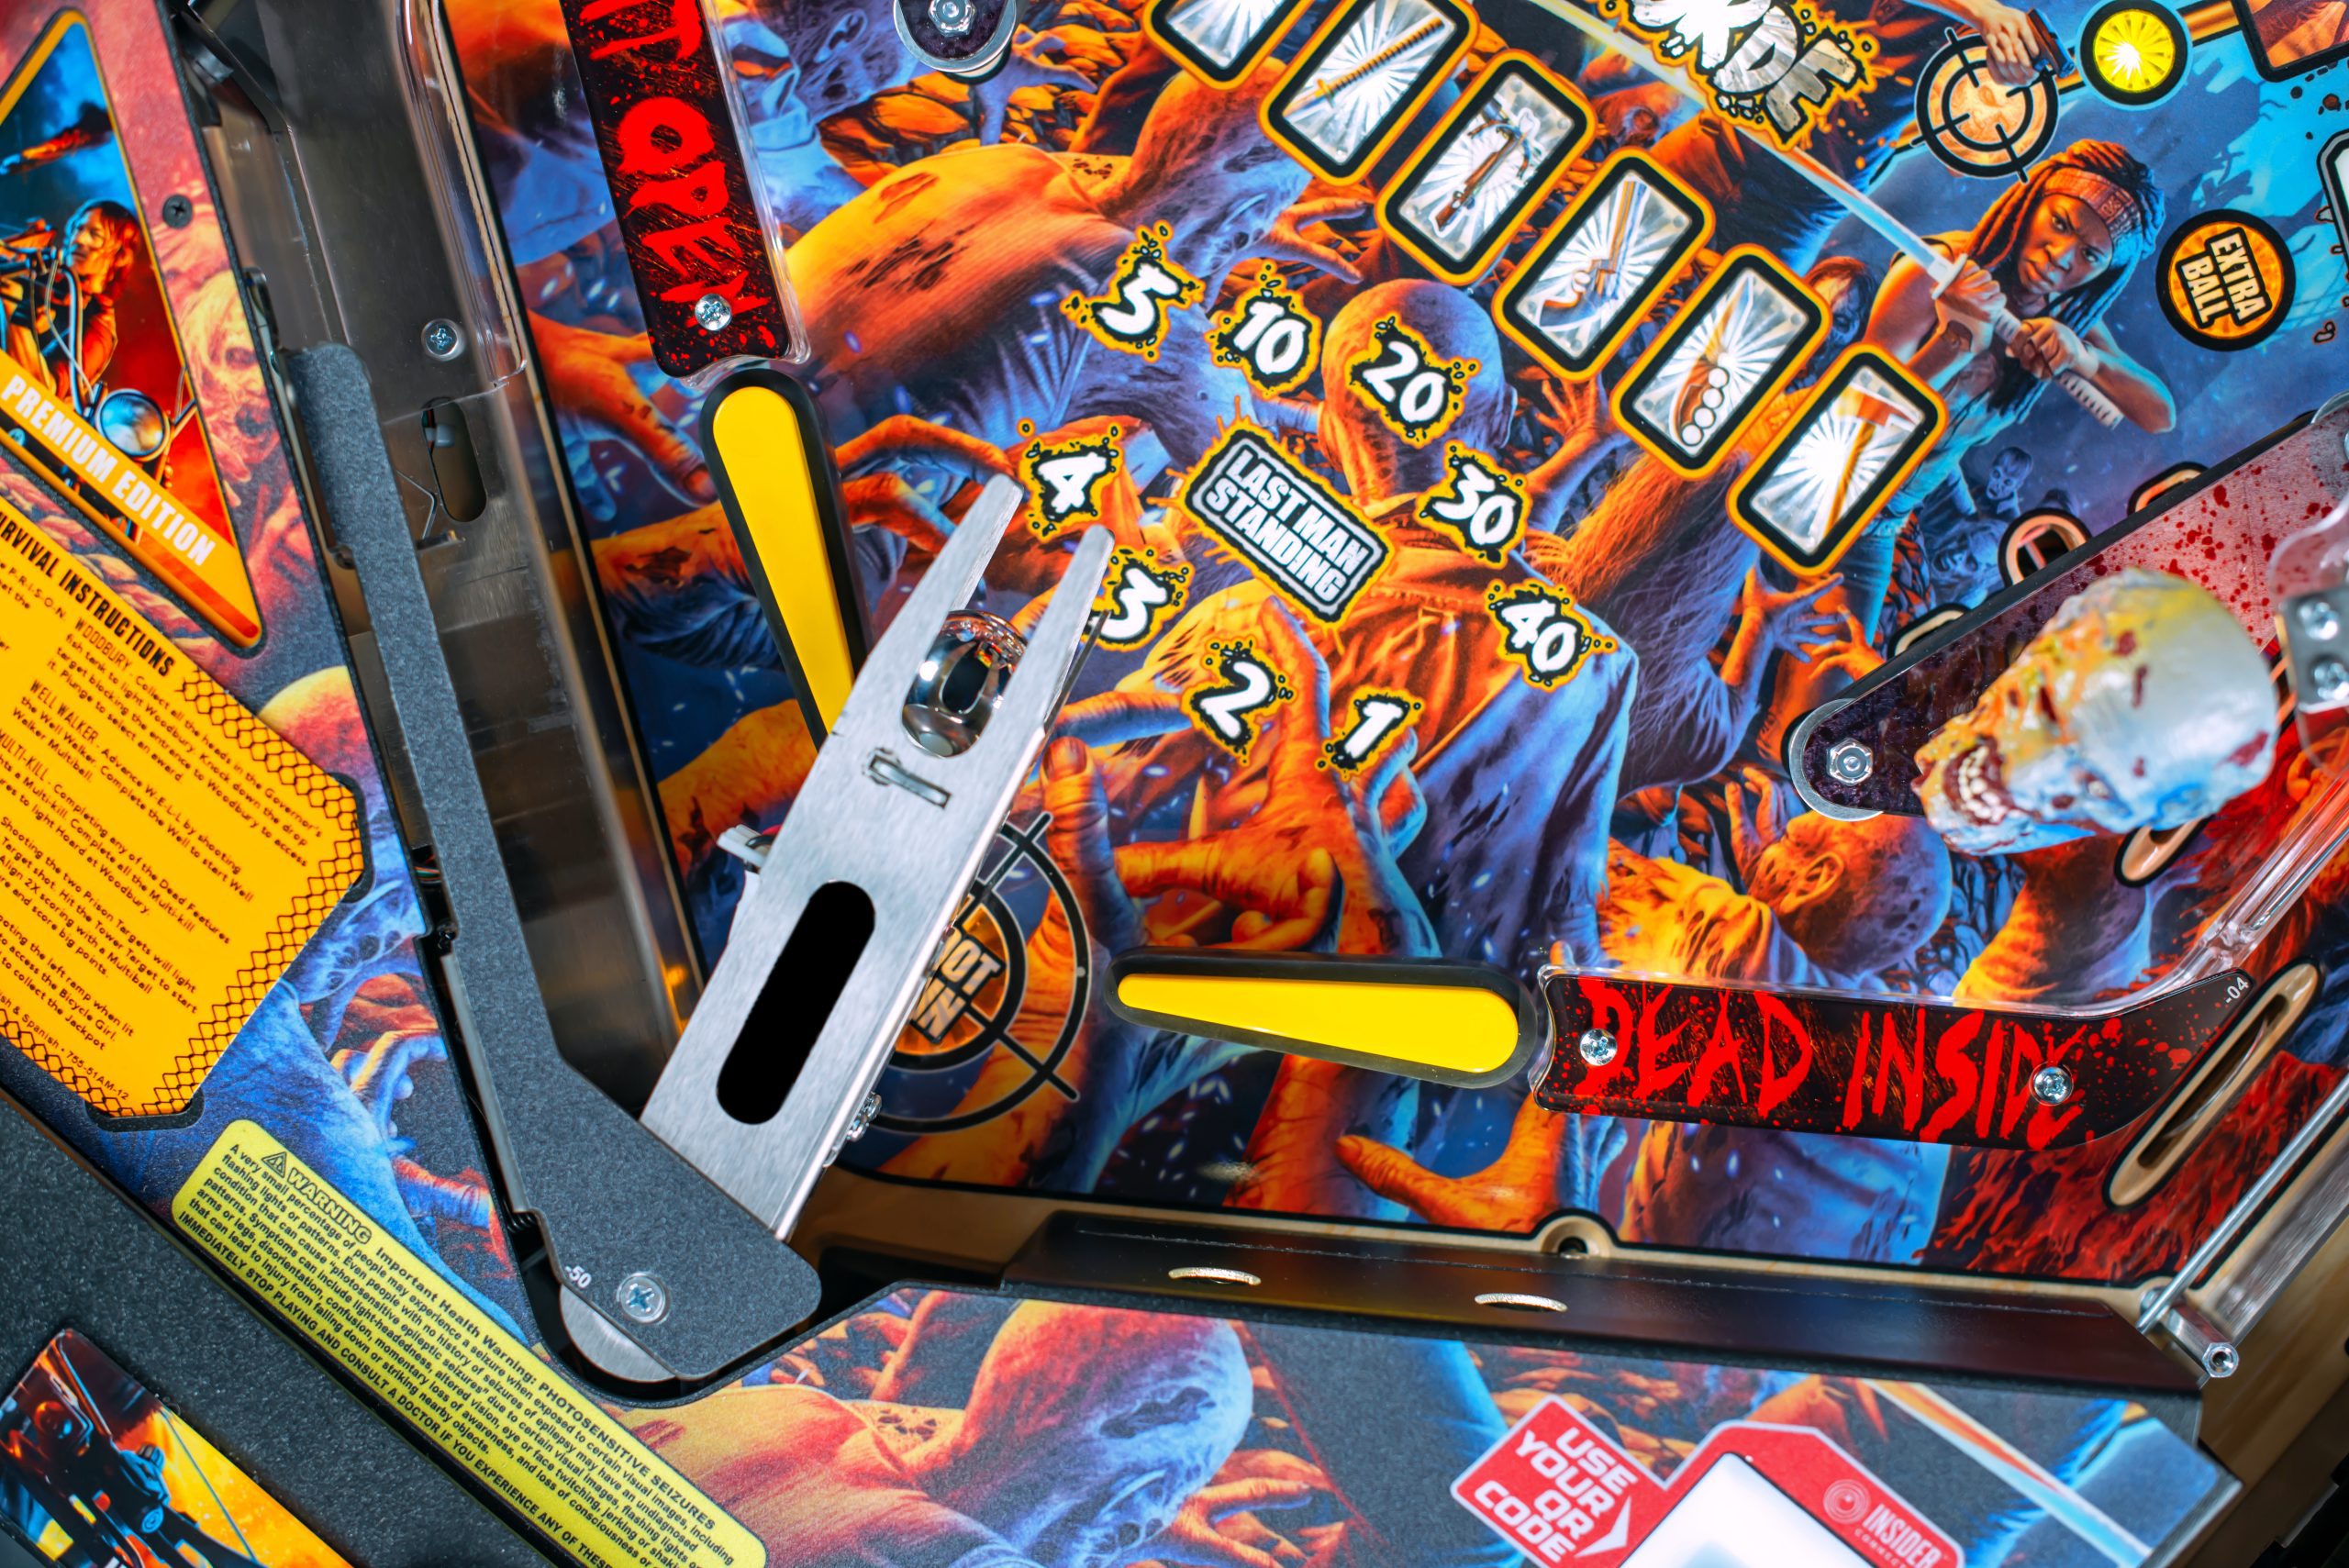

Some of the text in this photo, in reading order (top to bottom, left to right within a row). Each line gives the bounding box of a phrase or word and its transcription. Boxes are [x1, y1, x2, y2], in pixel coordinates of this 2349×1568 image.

[616, 96, 771, 328] OPEN
[1096, 262, 1180, 335] 5
[2180, 255, 2230, 324] BALL
[2210, 232, 2266, 321] EXTRA
[1233, 301, 1308, 374] 10
[1363, 340, 1447, 423] 20
[2, 374, 216, 567] PREMIUM EDITION
[1037, 451, 1108, 515] 4
[1225, 449, 1371, 576] LAST MAN
[1431, 463, 1517, 546] 30
[1205, 477, 1347, 603] STANDING
[59, 568, 176, 677] INSTRUCTIONS
[1088, 567, 1168, 639] 3
[1500, 599, 1577, 673] 40
[65, 632, 307, 846] fish tank to light Woodbury. Knock down the drop
[73, 617, 322, 838] WOODBURY Collect all the heads in the Governor's
[1199, 661, 1271, 738] 2
[1343, 701, 1403, 759] 1
[29, 679, 241, 875] WELL WALKER Advance W-E-L-L by shooting
[56, 646, 307, 867] target blocking the entrance to Woodbury to access
[1, 816, 196, 994] Shooting the two Prison Targets will light
[2, 835, 198, 1014] Target shot. Hit the Tower Target to start
[1, 956, 106, 1051] to collect the Jackpot
[2225, 976, 2249, 1003] -04
[20, 1013, 129, 1101] Spanish 755-51AM-12
[1575, 976, 2087, 1151] DEAD INSIDE
[564, 1265, 592, 1289] -50
[188, 1197, 489, 1454] that can lead to injury from falling down or striking nearby objects.
[221, 1152, 699, 1552] flashing lights or patterns. Even people with no history of seizures of epilepsy may have an undiagnosed
[228, 1143, 735, 1566] A very small percentage of people may experience a seizure when exposed to certain visual images, including
[285, 1167, 716, 1530] WARNING Important Health Warning: PHOTOSENSITIVE SEIZURES
[178, 1210, 248, 1270] IMMEDIATELY
[245, 1267, 274, 1292] STOP
[272, 1290, 318, 1331] PLAYING
[316, 1328, 340, 1350] AND
[340, 1347, 390, 1389] CONSULT
[386, 1386, 397, 1399] A
[396, 1394, 441, 1434] DOCTOR
[439, 1429, 453, 1441] IF
[451, 1439, 476, 1462] YOU
[473, 1458, 540, 1516] EXPERIENCE
[536, 1511, 563, 1533] ANY
[561, 1530, 579, 1545] OF
[1513, 1429, 1616, 1519] YOUR
[1555, 1426, 1639, 1496] USE
[1473, 1479, 1576, 1563] CODE
[1532, 1488, 1595, 1541] QR
[1862, 1504, 1943, 1568] INSIDER
